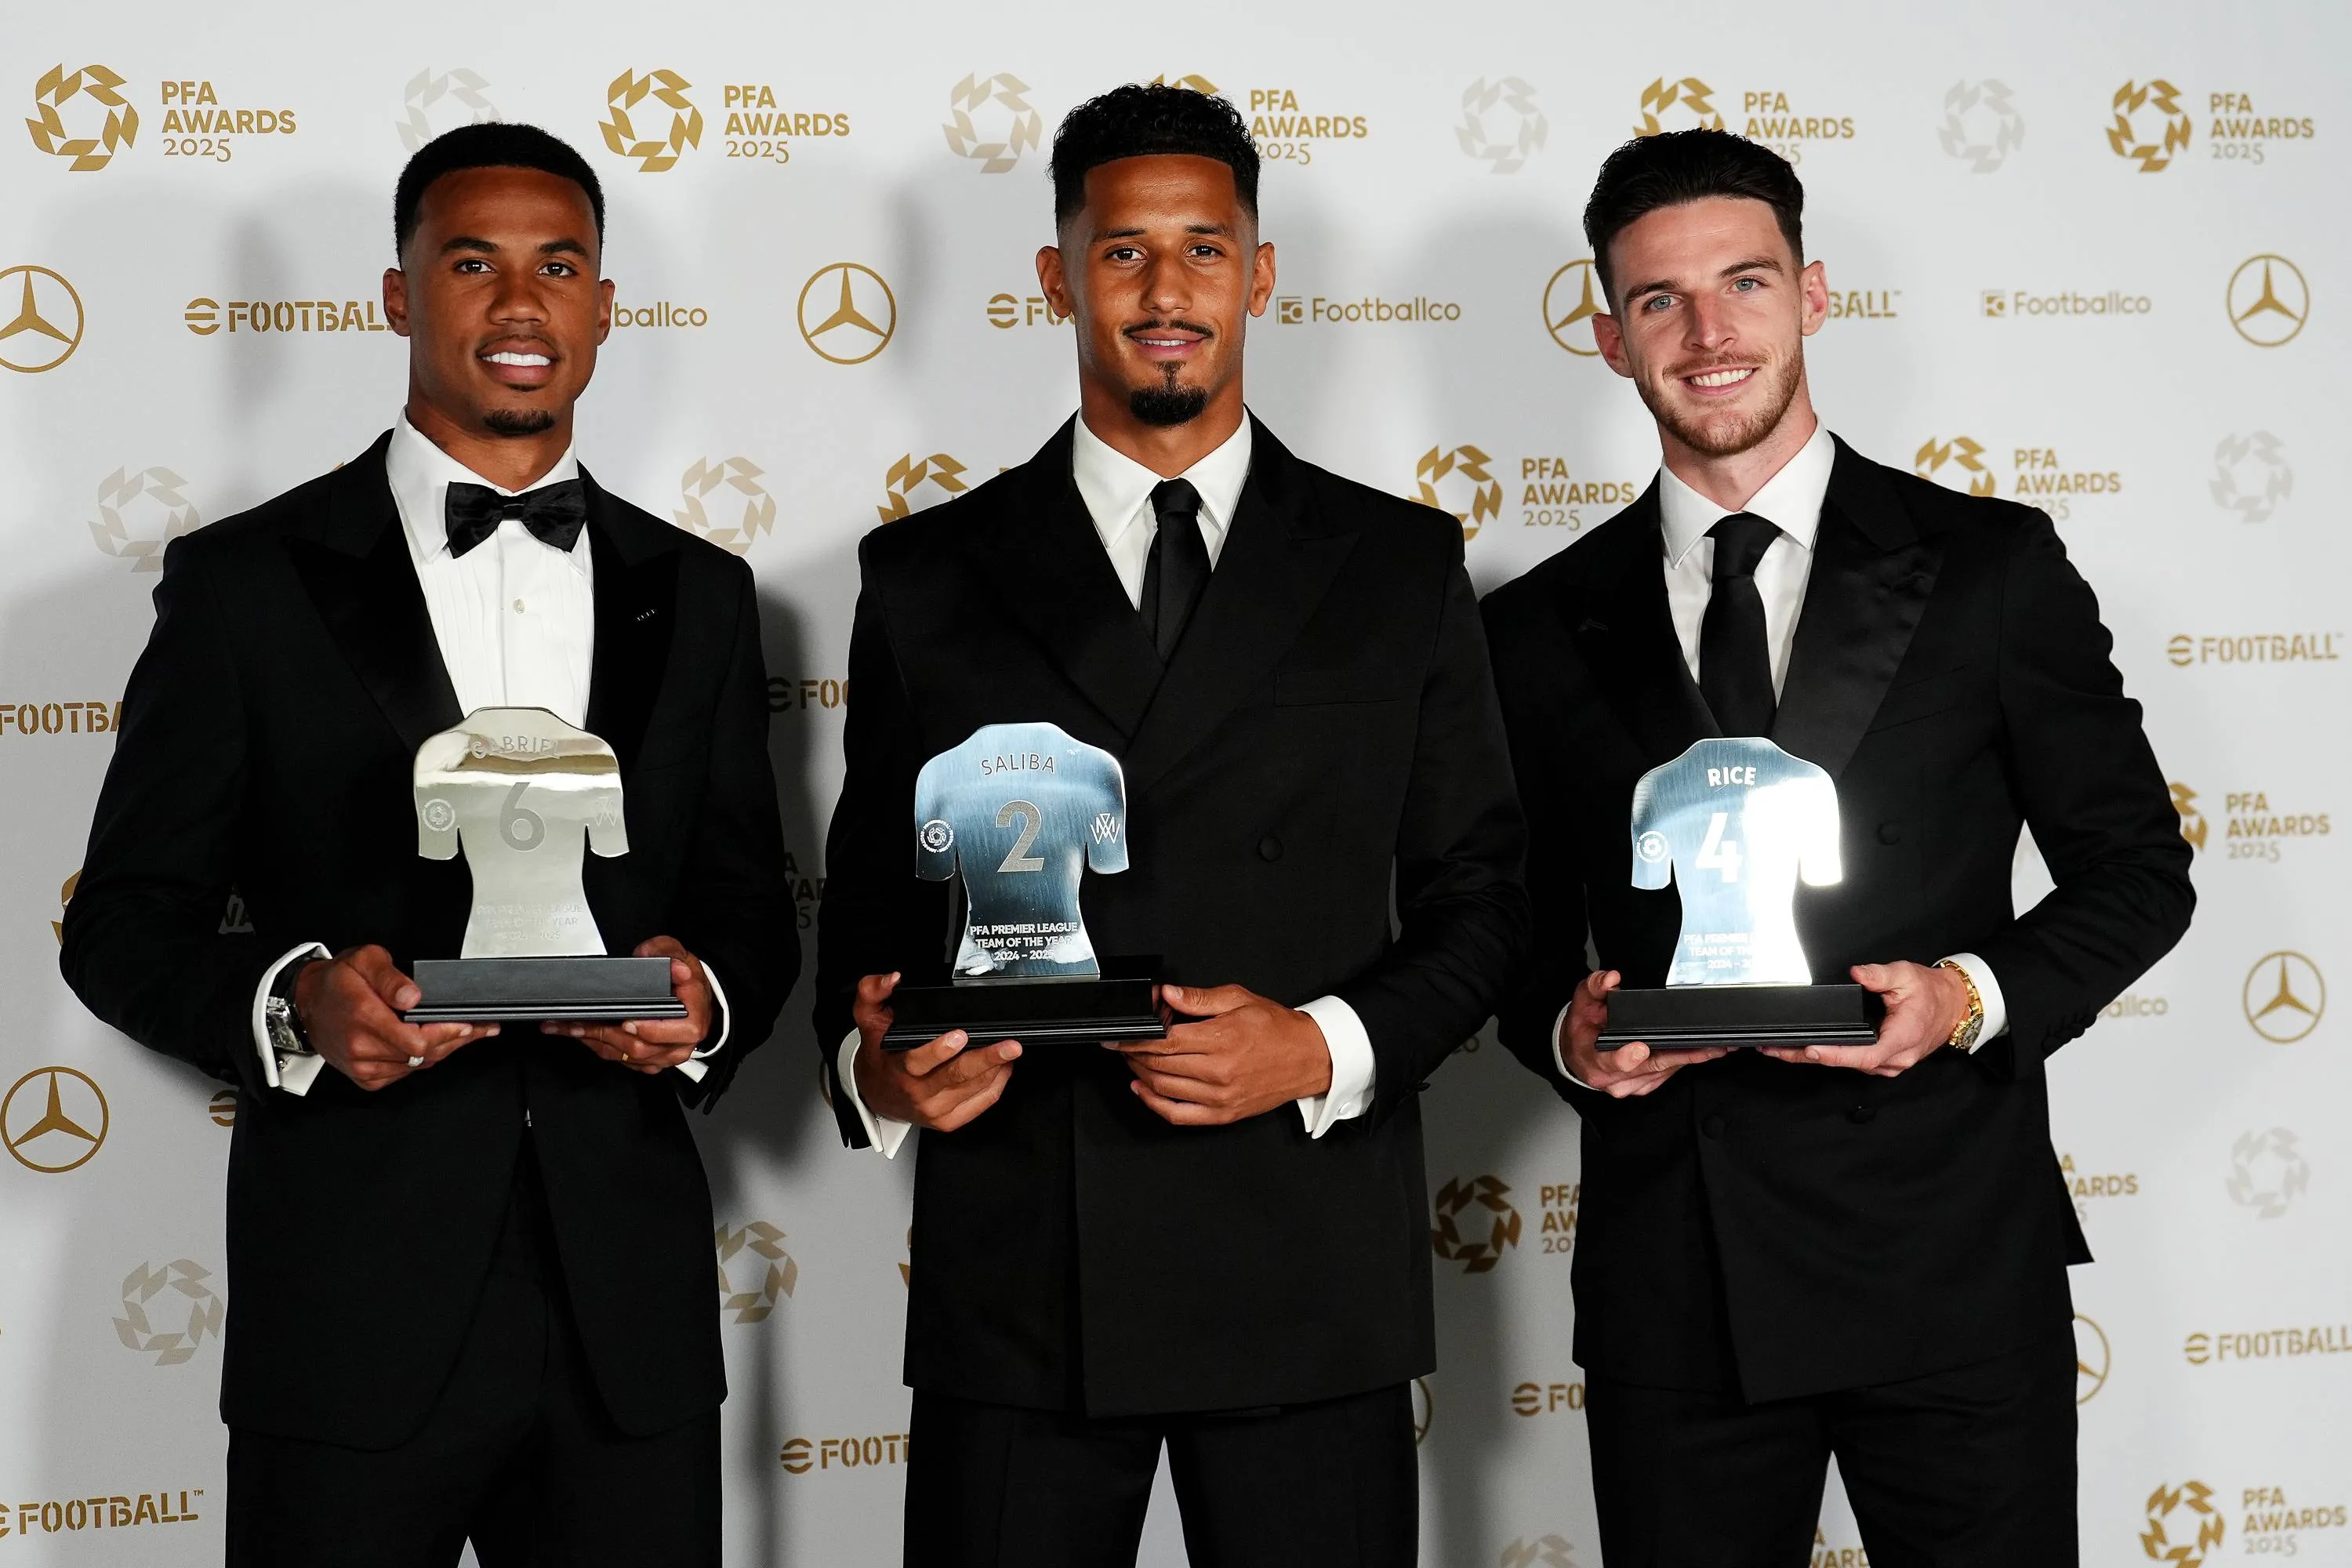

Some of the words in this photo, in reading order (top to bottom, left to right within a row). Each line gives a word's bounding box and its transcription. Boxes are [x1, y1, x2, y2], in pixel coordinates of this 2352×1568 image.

[162, 82, 217, 105] PFA
[724, 85, 776, 108] PFA
[1250, 89, 1298, 111] PFA
[1744, 92, 1789, 113] PFA
[2210, 93, 2252, 114] PFA
[162, 110, 296, 134] AWARDS
[724, 113, 850, 136] AWARDS
[1252, 116, 1367, 138] AWARDS
[1746, 118, 1855, 138] AWARDS
[2210, 118, 2314, 139] AWARDS
[163, 139, 231, 162] 2025
[726, 141, 789, 163] 2025
[1767, 143, 1802, 165] 25
[2212, 143, 2265, 165] 2025
[614, 301, 708, 327] ballco
[1312, 296, 1461, 321] Footballco
[2014, 291, 2151, 315] Footballco
[229, 301, 392, 332] FOOTBAL
[1522, 458, 1568, 480] PFA
[2014, 448, 2058, 469] PFA
[1523, 482, 1635, 505] AWARDS
[2015, 472, 2122, 494] AWARDS
[1524, 509, 1581, 531] 2025
[981, 753, 1055, 775] SALIBA
[1707, 766, 1757, 787] RICE
[2226, 792, 2268, 813] PFA
[499, 782, 546, 853] 6
[2226, 815, 2331, 839] AWARDS
[995, 800, 1044, 873] 2
[1695, 812, 1743, 883] 4
[2227, 840, 2281, 862] 2025
[969, 926, 989, 936] PFA
[992, 924, 1036, 935] PREMIER
[1037, 922, 1077, 933] LEAGUE
[1683, 934, 1704, 945] PFA
[975, 938, 1004, 949] TEAM
[1006, 938, 1022, 947] OF
[1023, 937, 1044, 946] THE
[1045, 935, 1073, 946] YEAR
[1690, 946, 1717, 956] TEAM
[1719, 946, 1733, 956] OF
[993, 951, 1021, 961] 2024
[2243, 1487, 2286, 1509] PFA
[2243, 1507, 2348, 1534] AWARDS
[2245, 1534, 2298, 1558] 2025
